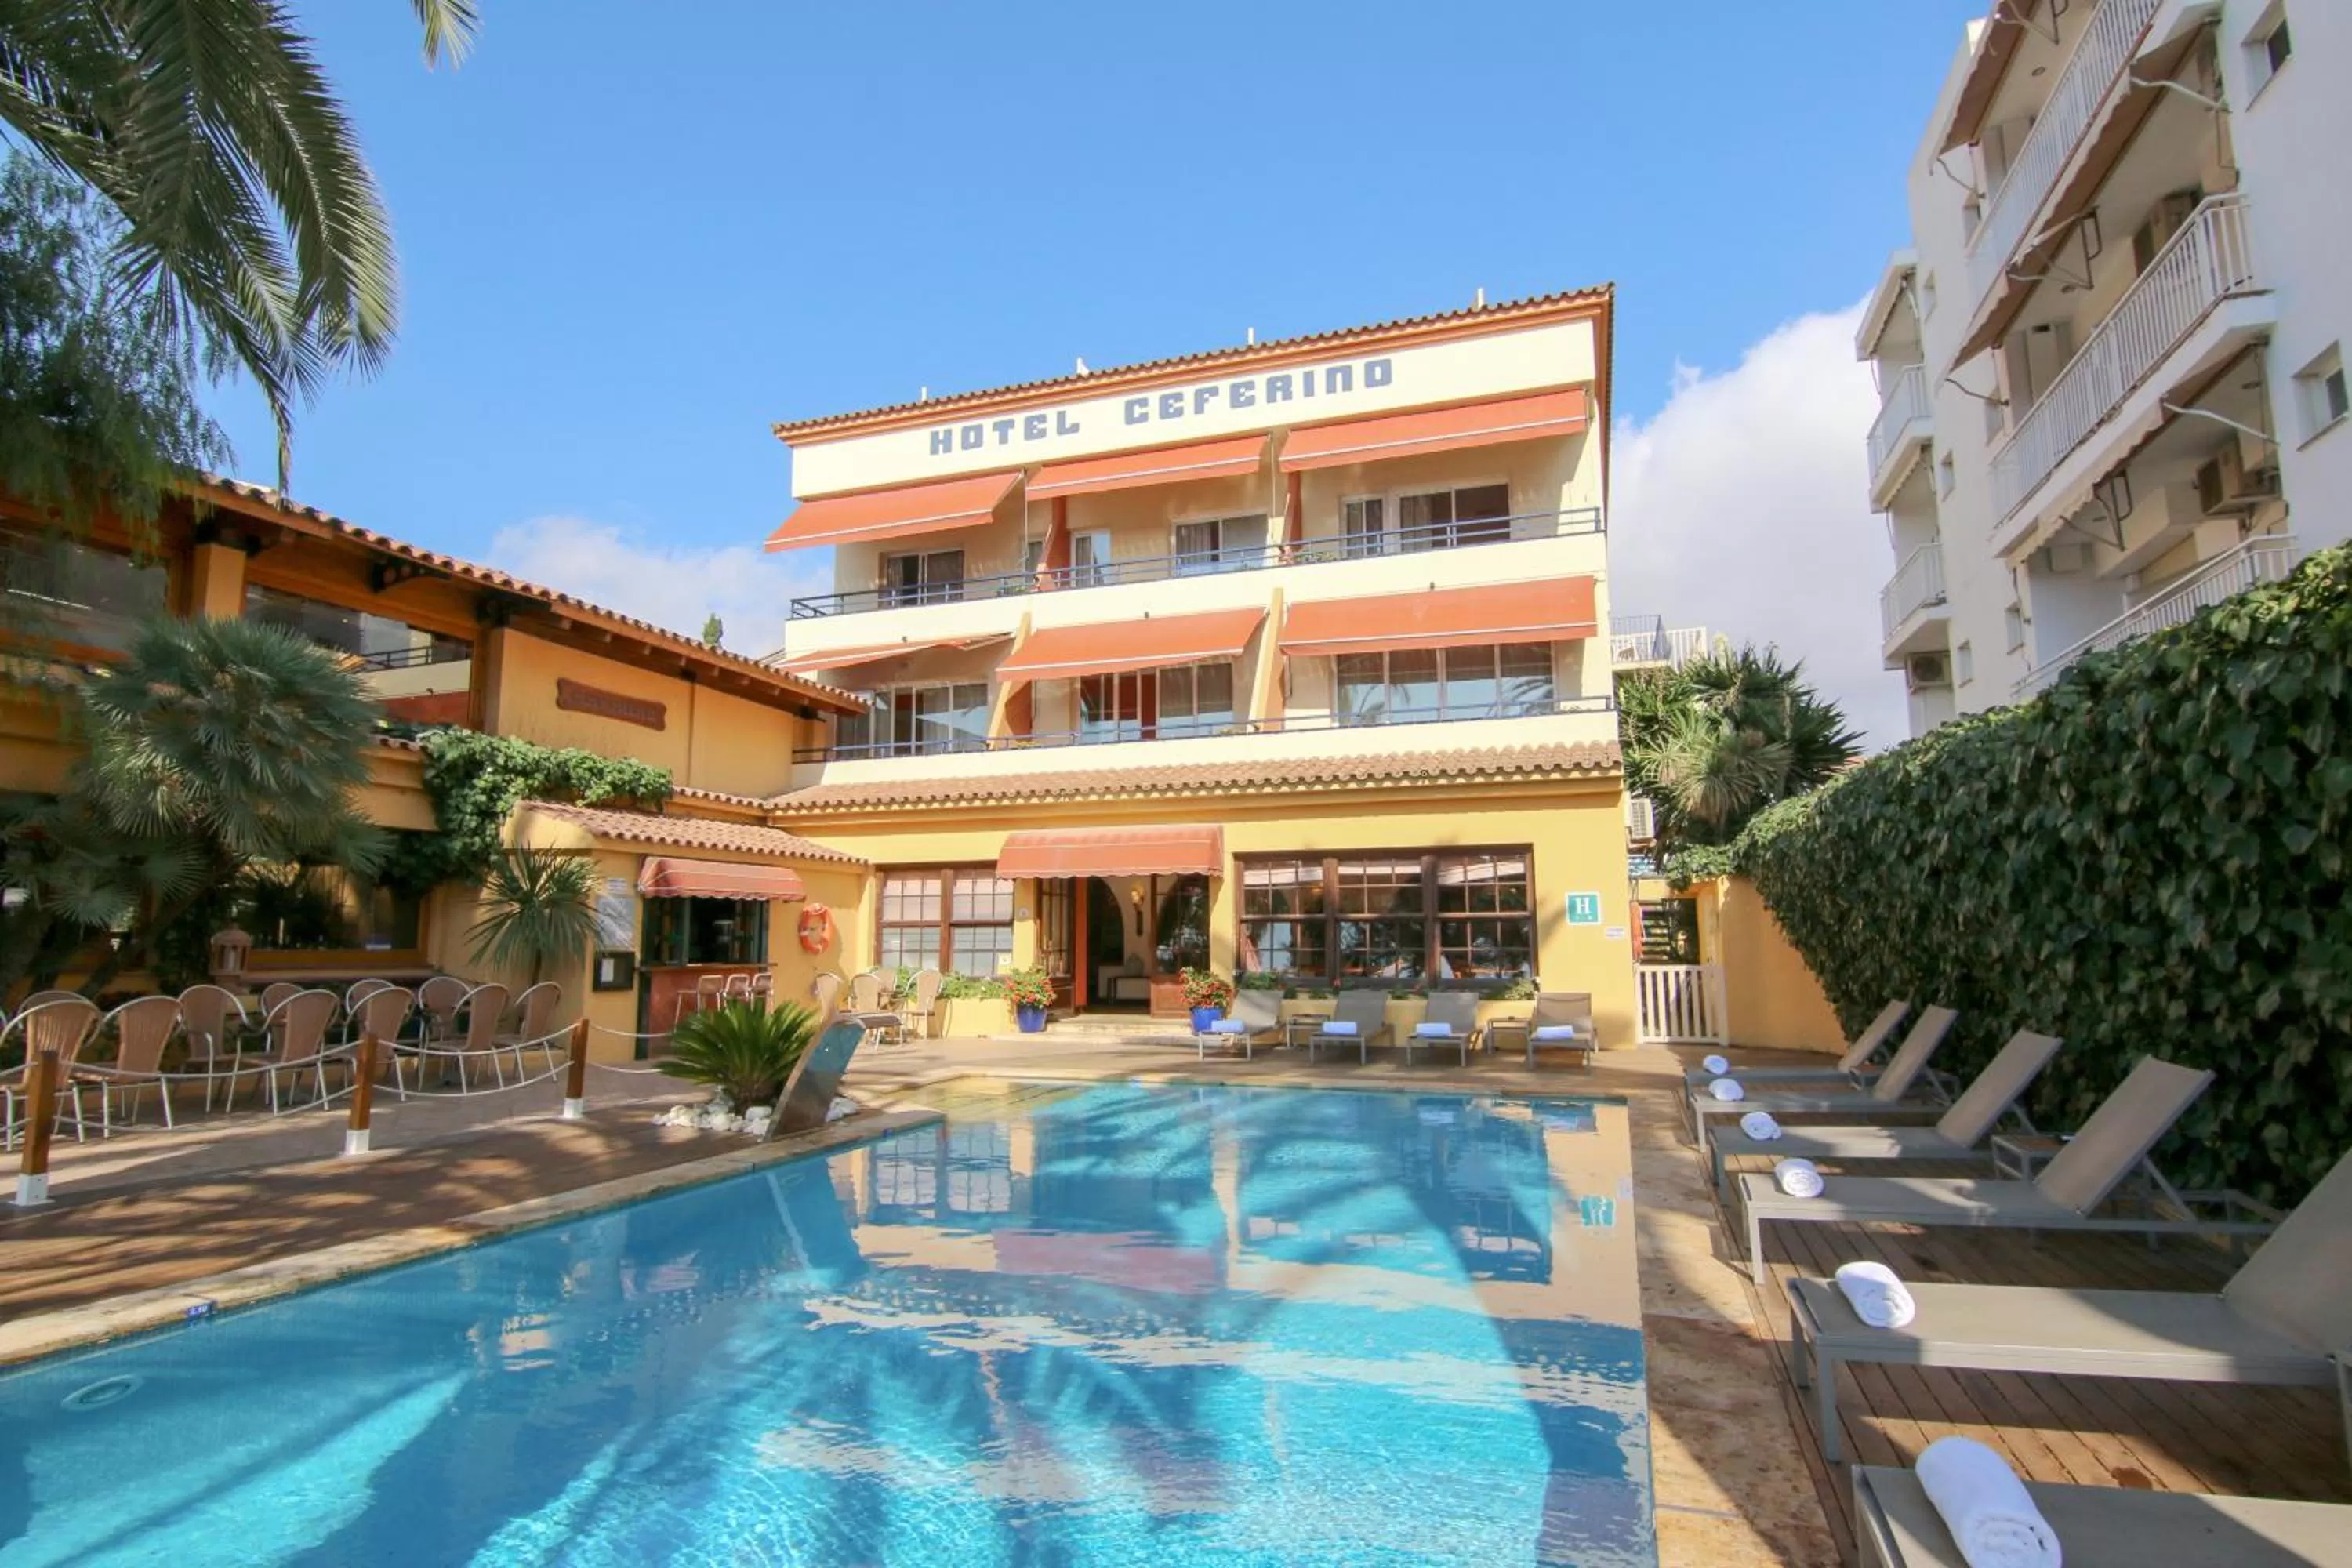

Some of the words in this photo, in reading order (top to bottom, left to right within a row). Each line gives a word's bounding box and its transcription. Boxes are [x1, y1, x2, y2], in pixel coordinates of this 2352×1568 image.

[930, 410, 1080, 456] HOTEL
[1123, 358, 1392, 426] CEFERINO
[1573, 896, 1592, 915] H
